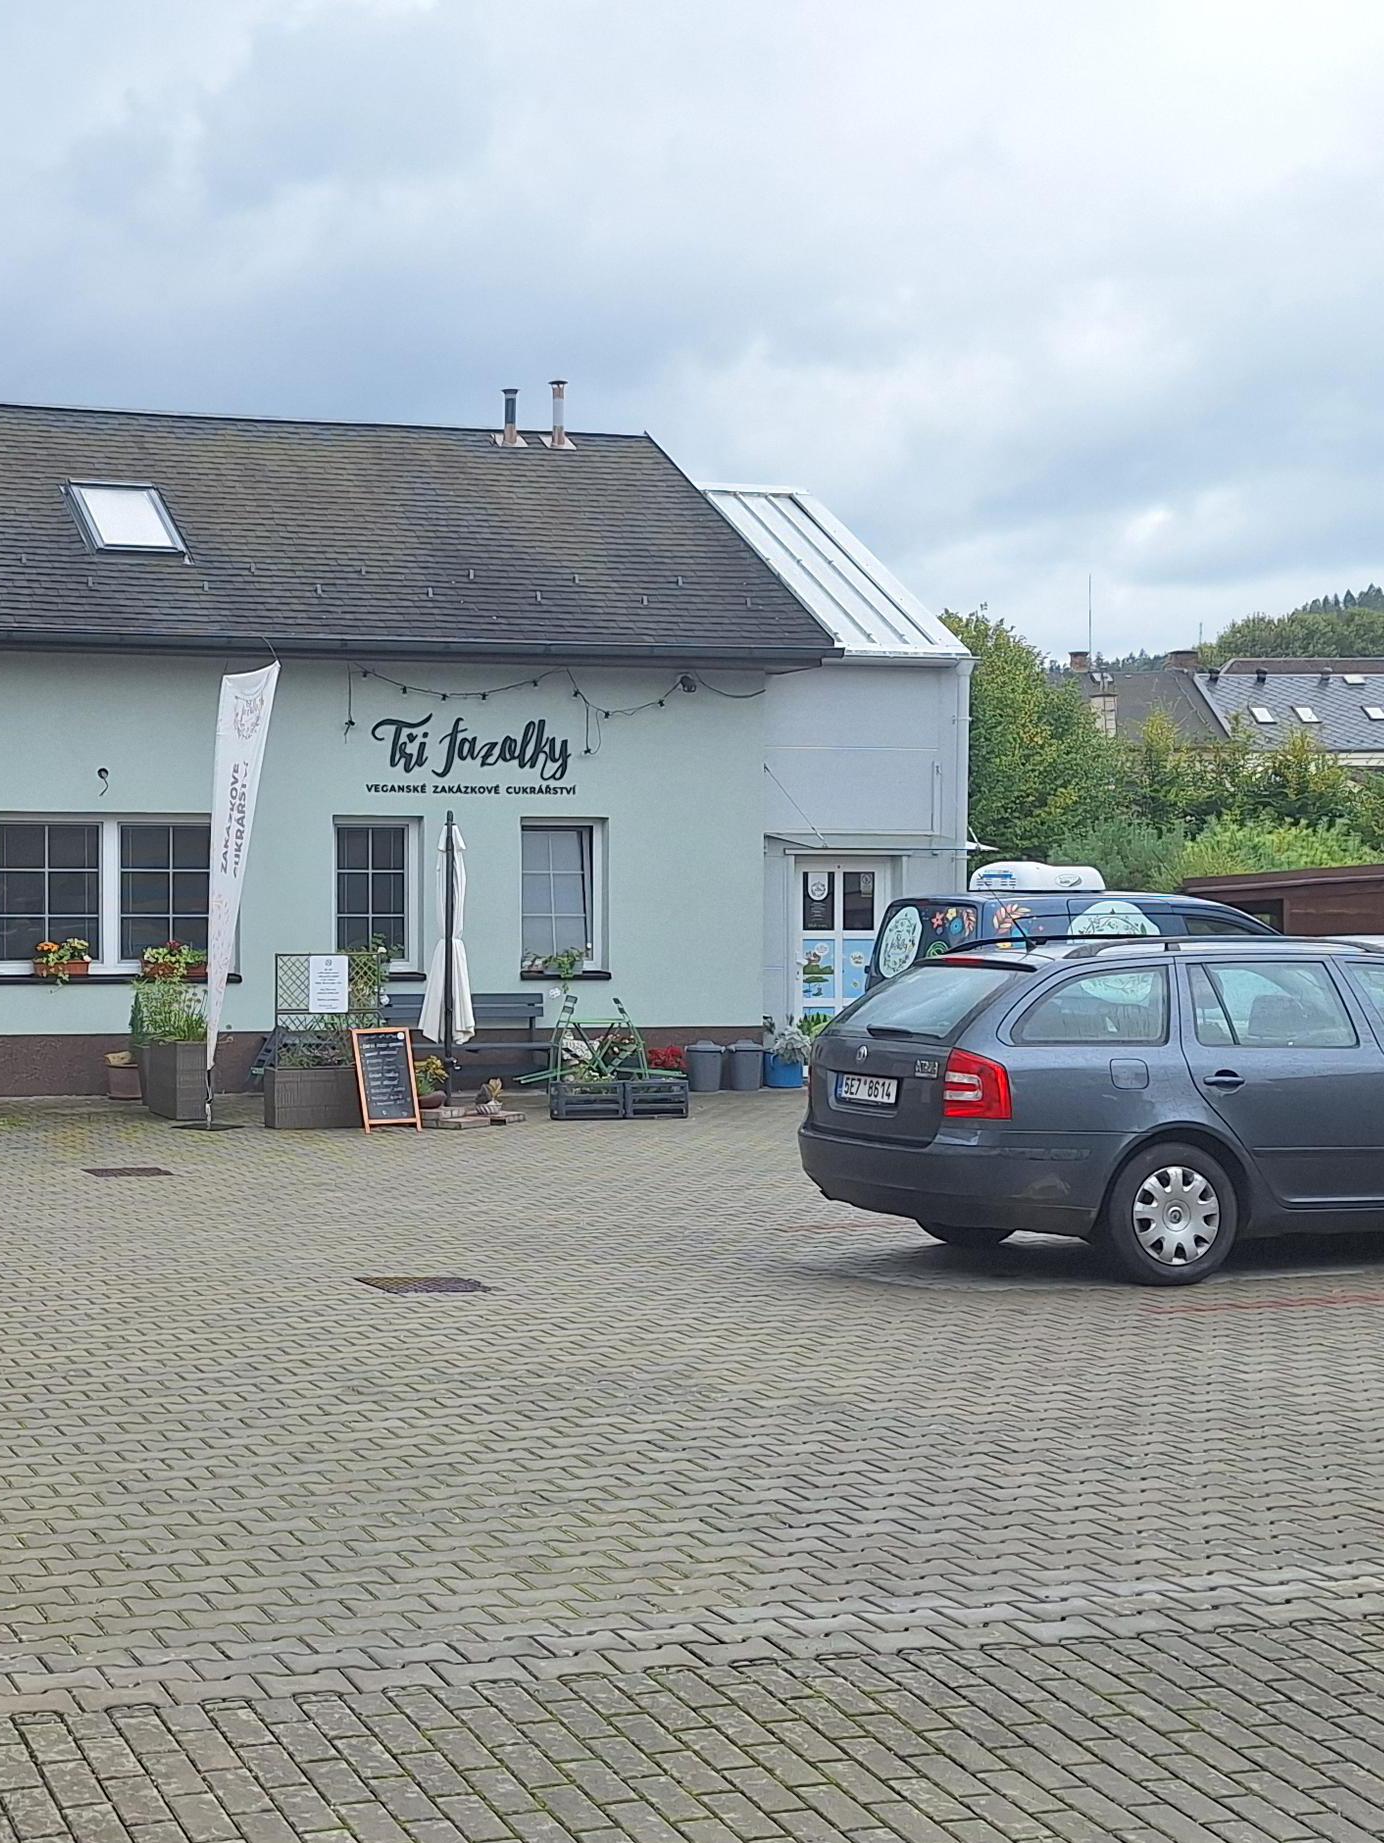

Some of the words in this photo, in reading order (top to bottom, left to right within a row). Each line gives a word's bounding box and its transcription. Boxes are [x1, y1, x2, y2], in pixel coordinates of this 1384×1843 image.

[371, 712, 433, 774] Tři
[431, 717, 572, 781] fazolky
[366, 783, 427, 794] VEGANSKÉ
[432, 783, 501, 795] ZAKÁZKOVÉ
[505, 784, 577, 796] CUKRÁŘSTVÍ
[844, 1077, 862, 1096] 5E7
[867, 1080, 892, 1100] 8614
